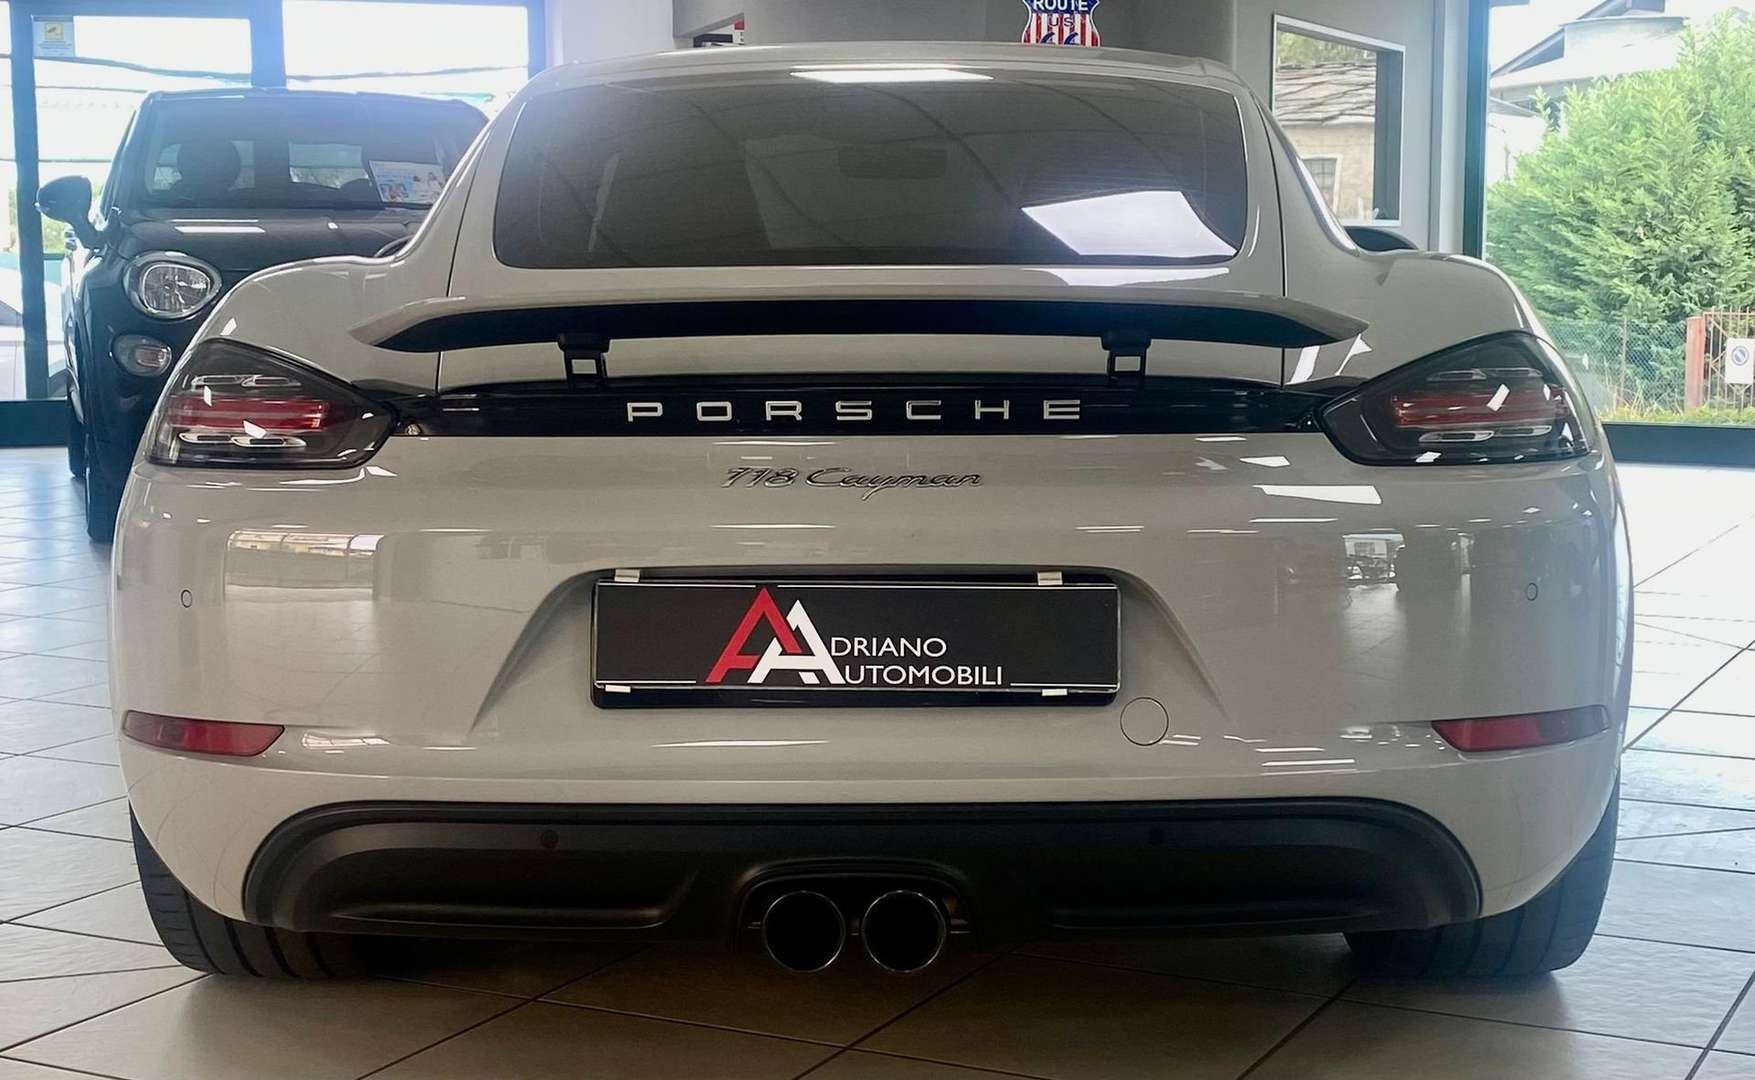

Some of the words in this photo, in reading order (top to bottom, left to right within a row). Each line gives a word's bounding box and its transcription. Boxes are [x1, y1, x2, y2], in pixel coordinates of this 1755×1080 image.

[1033, 0, 1088, 10] ROUTE
[626, 399, 1081, 422] PORSCHE
[721, 466, 799, 487] 718
[805, 466, 984, 501] Cayman
